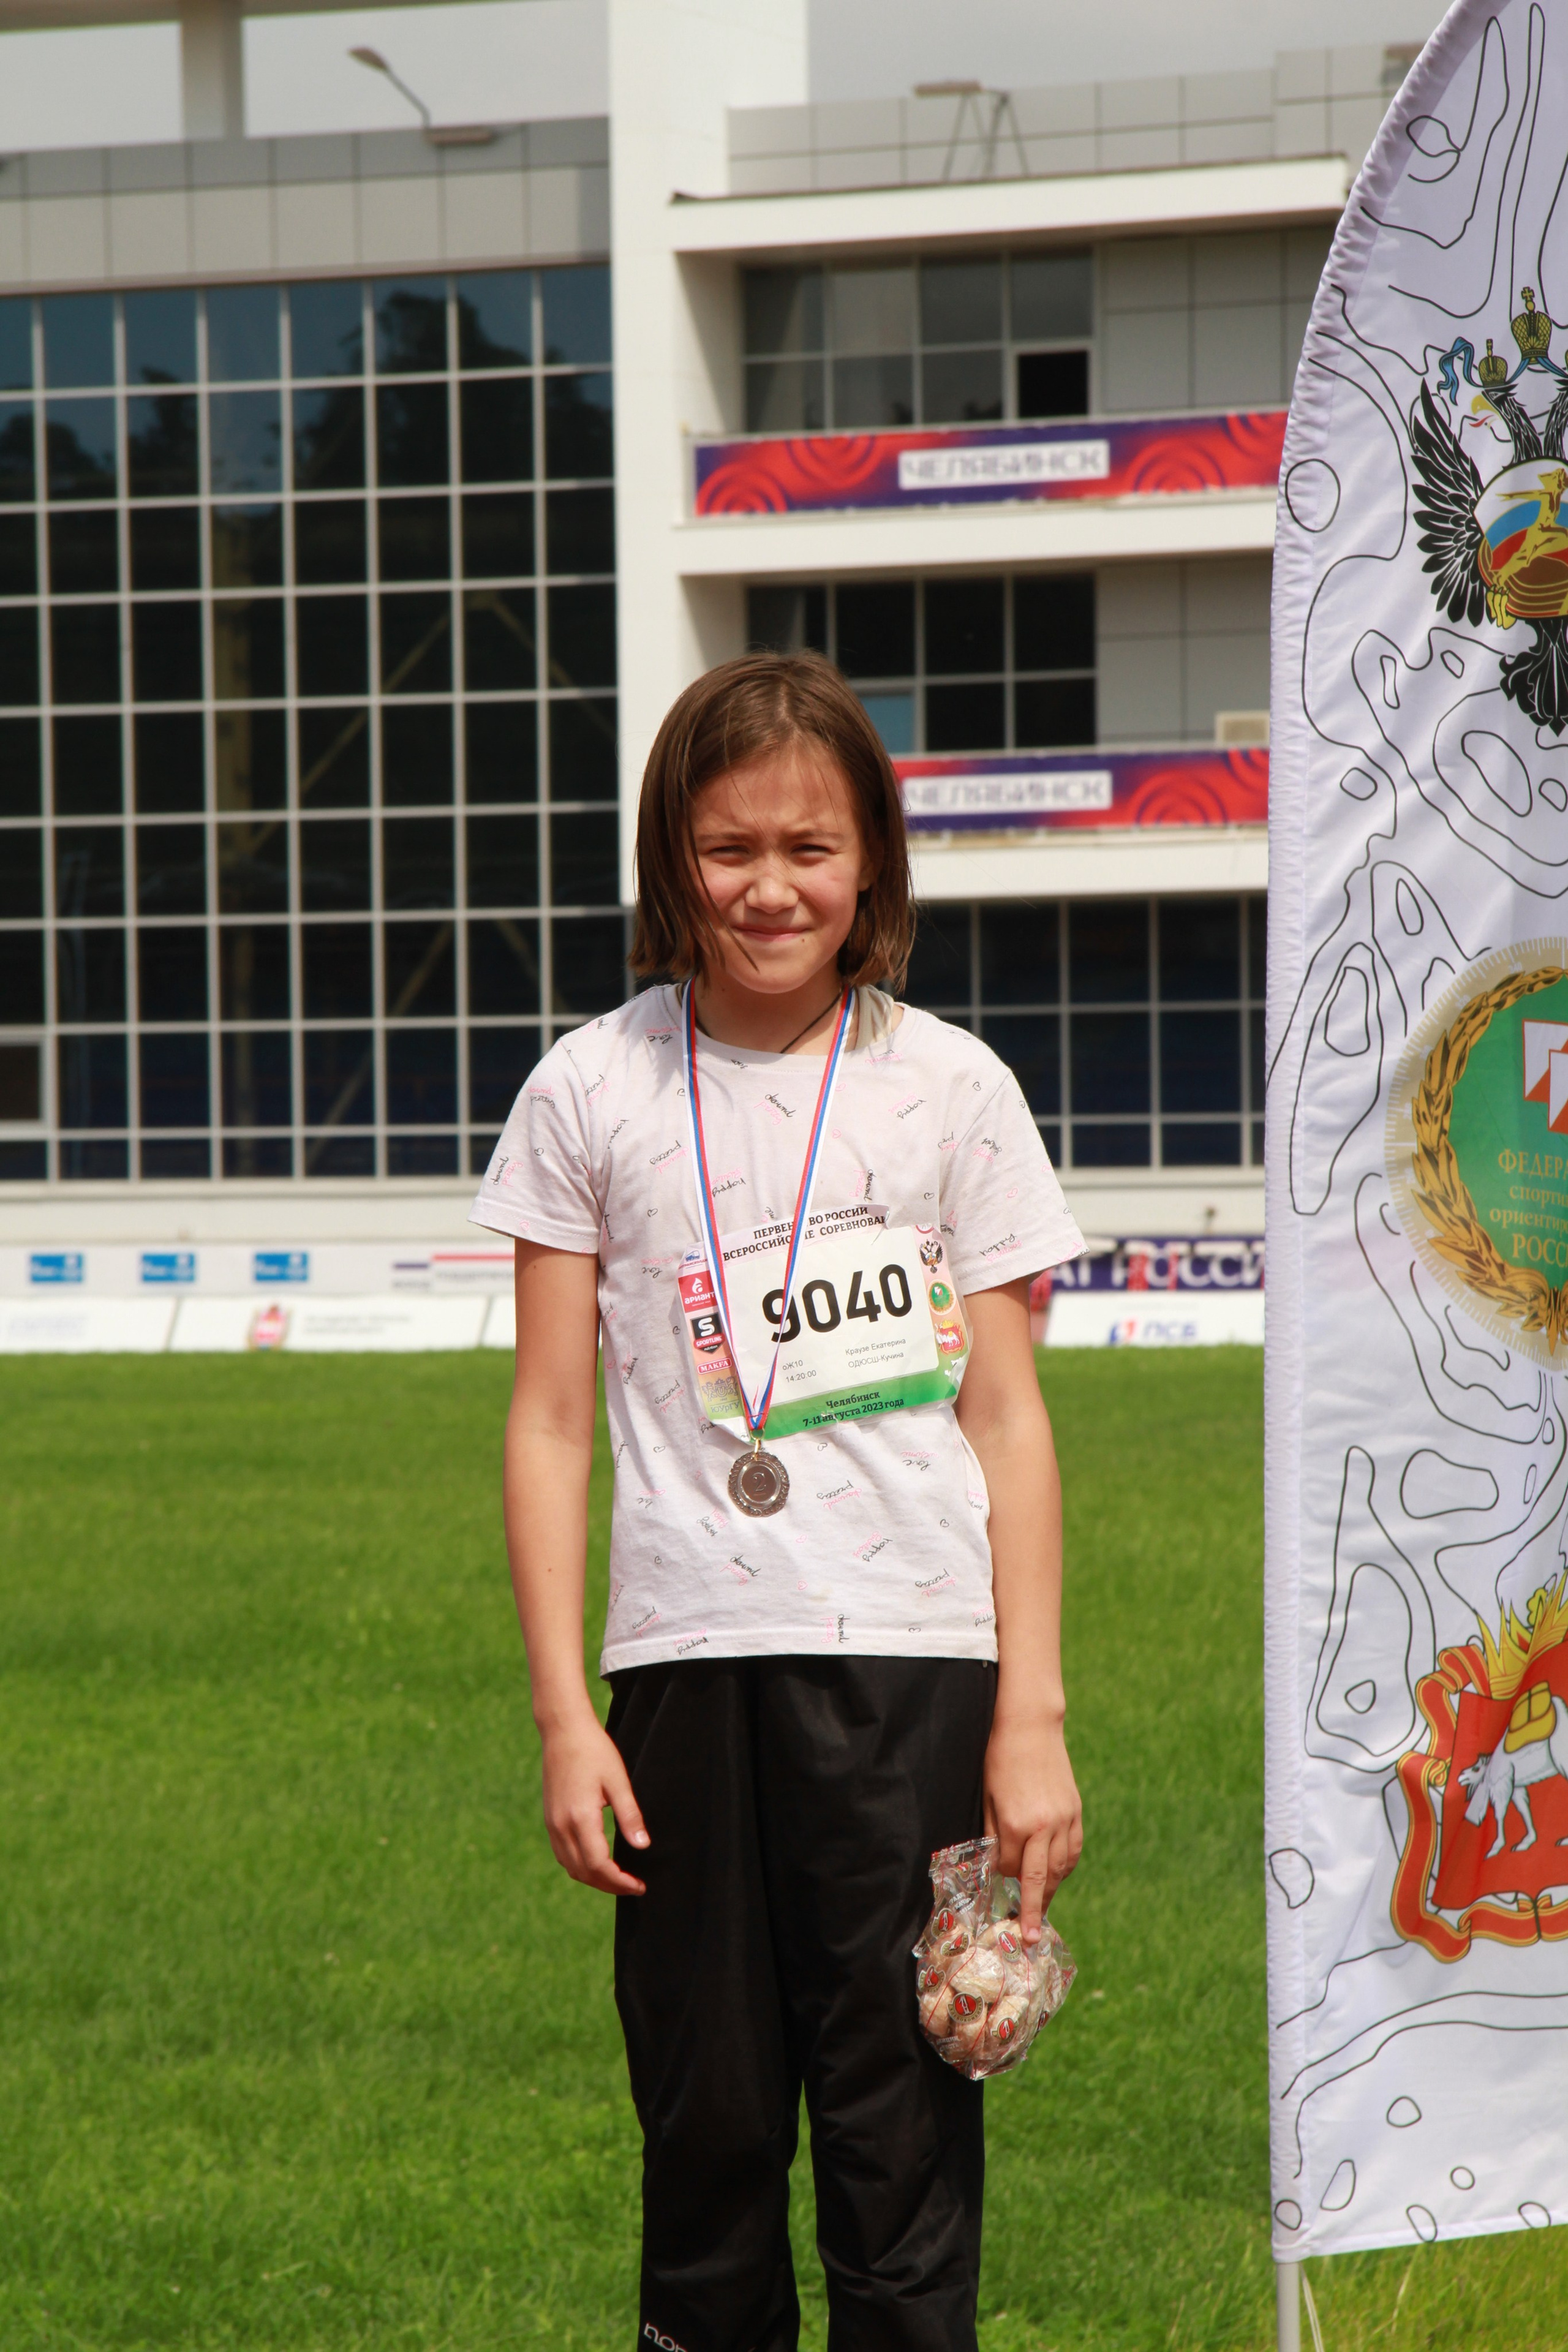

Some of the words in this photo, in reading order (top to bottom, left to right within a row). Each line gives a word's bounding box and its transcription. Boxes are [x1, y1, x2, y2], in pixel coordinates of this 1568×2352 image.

[753, 1215, 823, 1239] ПЕРВЕНВО
[826, 1206, 869, 1223] РОССИИ
[723, 1229, 815, 1262] ВСЕРОССИЙСЕ
[1512, 1233, 1568, 1268] РОСС
[762, 1264, 912, 1343] 9040
[845, 1345, 870, 1356] Краузе
[871, 1338, 907, 1351] Екатерина
[700, 1360, 730, 1373] MAKFA
[786, 1370, 816, 1383] 14:20:00
[826, 1390, 881, 1409] Челябинск
[862, 1401, 884, 1414] 2023
[885, 1398, 905, 1410] года
